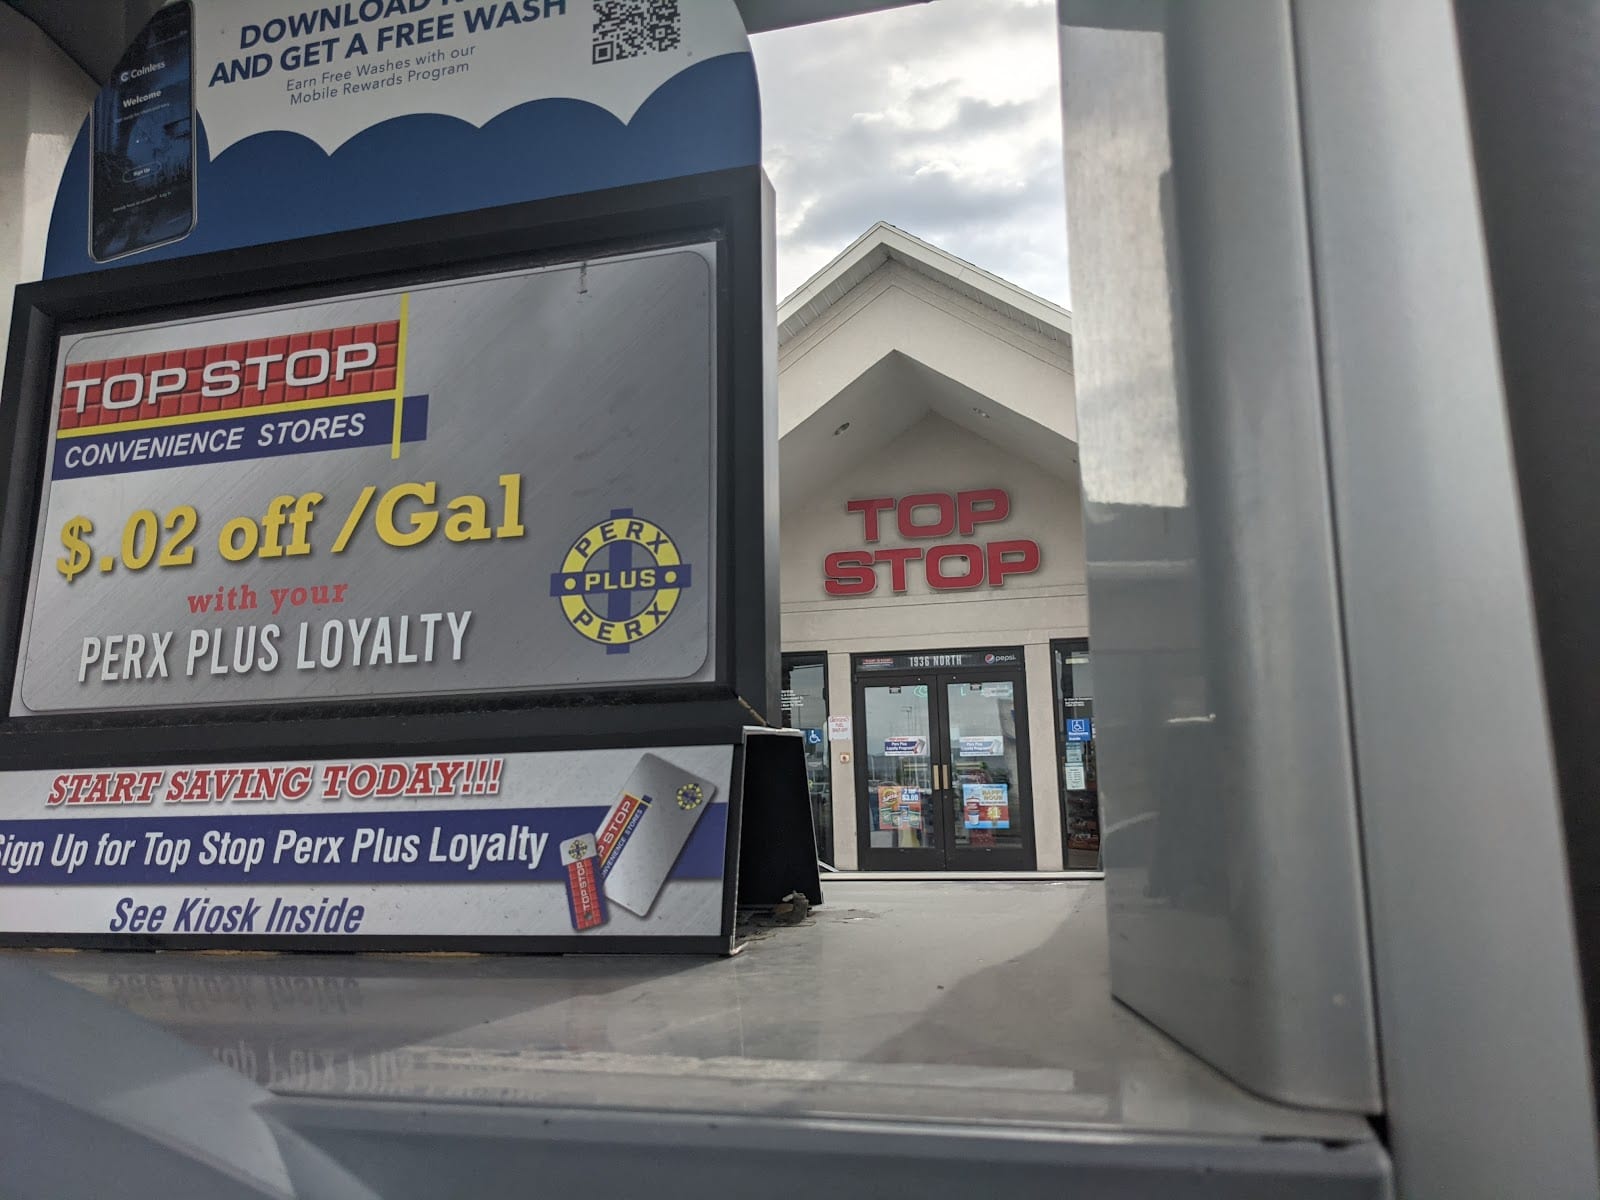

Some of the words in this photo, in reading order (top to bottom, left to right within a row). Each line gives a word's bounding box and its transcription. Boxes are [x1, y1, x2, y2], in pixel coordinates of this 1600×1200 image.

[208, 53, 273, 87] AND
[280, 37, 340, 71] GET
[345, 33, 369, 59] A
[376, 14, 455, 52] FREE
[463, 0, 567, 33] WASH
[239, 0, 432, 49] DOWNLOAD
[130, 61, 166, 79] Coinless
[286, 77, 316, 92] Earn
[322, 69, 352, 84] Free
[356, 58, 411, 77] Washes
[415, 49, 446, 66] with
[450, 44, 477, 61] our
[290, 84, 338, 106] Mobile
[343, 73, 403, 96] Rewards
[407, 62, 470, 84] Program
[122, 90, 162, 108] Welcome
[66, 367, 187, 414] TOP
[200, 342, 377, 398] STOP
[64, 427, 245, 469] CONVENIENCE
[257, 413, 366, 447] STORES
[56, 504, 198, 582] $.02
[218, 492, 324, 561] off
[847, 488, 1010, 542] TOP
[574, 520, 669, 558] PERX
[585, 569, 656, 591] PLUS
[824, 539, 1040, 595] STOP
[187, 586, 257, 614] with
[270, 584, 348, 615] your
[572, 602, 669, 641] PERX
[78, 632, 173, 683] PERX
[186, 624, 280, 676] PLUS
[297, 611, 473, 670] LOYALTY
[910, 656, 929, 667] 1936
[933, 654, 962, 667] NORTH
[996, 655, 1016, 663] pepsi
[47, 771, 162, 805] START
[166, 767, 311, 801] SAVING
[322, 759, 502, 798] TODAY!!!
[603, 800, 632, 844] STOP
[51, 833, 89, 873] Up
[95, 832, 135, 867] for
[144, 832, 188, 871] Top
[199, 831, 264, 872] Stop
[273, 830, 341, 864] Perx
[352, 828, 419, 863] Plus
[429, 825, 548, 870] Loyalty
[601, 835, 628, 878] ONVENIENCE
[110, 897, 164, 932] See
[174, 898, 261, 933] Kiosk
[265, 896, 365, 933] Inside
